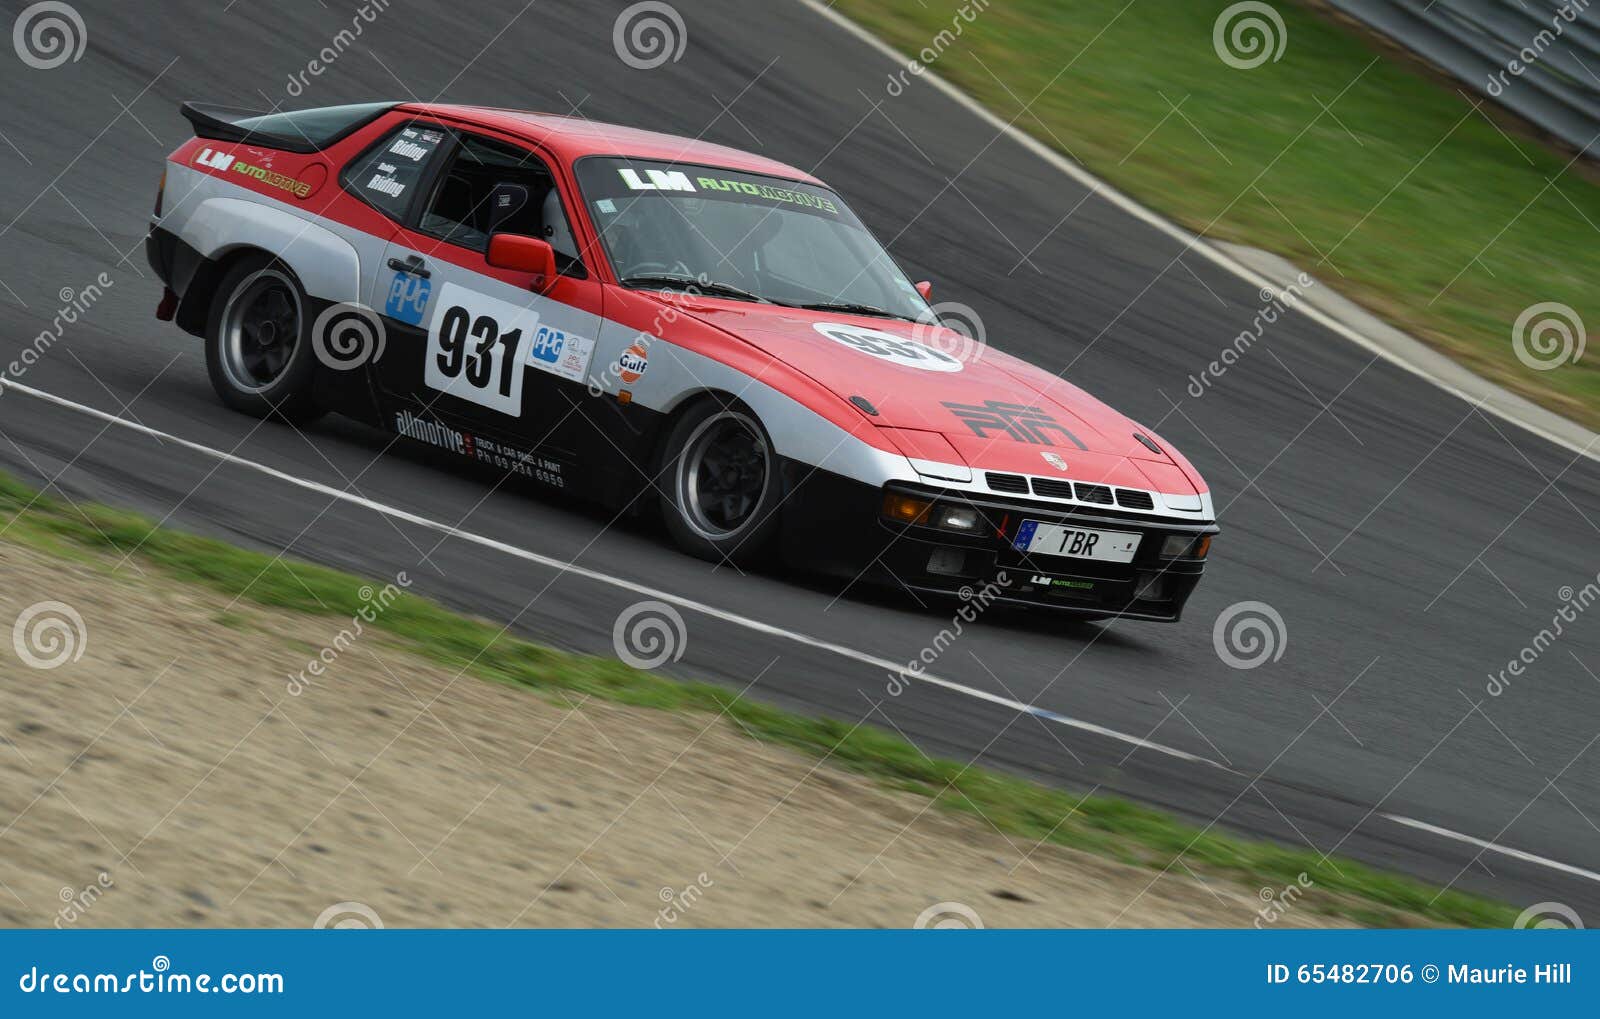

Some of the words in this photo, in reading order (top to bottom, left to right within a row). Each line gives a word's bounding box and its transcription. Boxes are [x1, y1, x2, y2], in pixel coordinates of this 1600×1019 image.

[389, 139, 428, 162] Riding
[196, 148, 236, 171] LM
[232, 161, 312, 198] AUTOMOTIVE
[366, 174, 406, 198] Riding
[617, 168, 697, 192] LM
[697, 177, 838, 214] AUTOMOTIVE
[388, 275, 429, 314] PPG
[436, 306, 522, 398] 931
[534, 328, 563, 356] PPG
[827, 330, 957, 363] 931
[620, 354, 647, 373] Gulf
[474, 436, 495, 451] TRUCK
[503, 446, 516, 459] CAR
[1058, 529, 1100, 557] TBR
